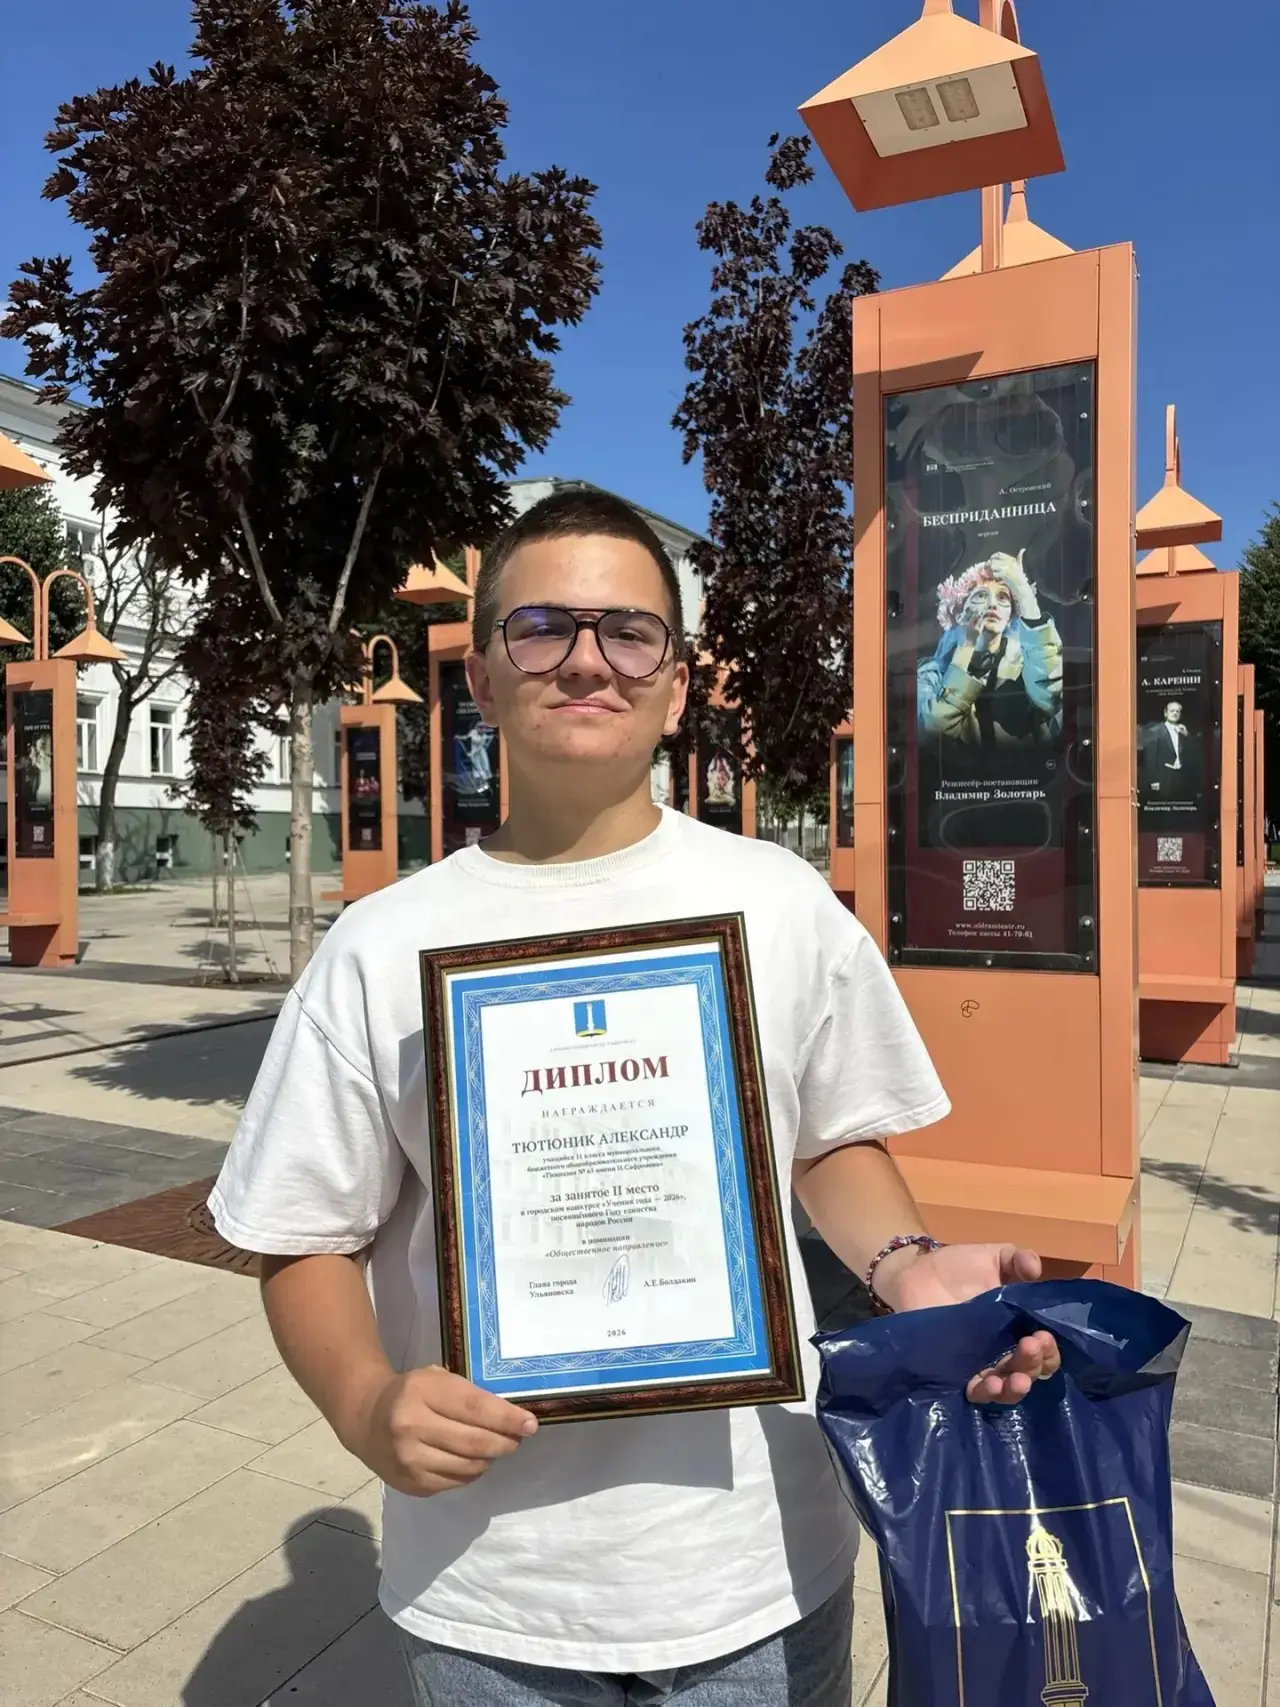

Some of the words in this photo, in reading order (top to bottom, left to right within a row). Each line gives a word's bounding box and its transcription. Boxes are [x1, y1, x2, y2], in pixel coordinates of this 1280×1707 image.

[1009, 482, 1051, 494] Островский
[923, 501, 1056, 528] БЕСПРИДАННИЦА
[1153, 676, 1201, 686] КАРЕНИН
[941, 778, 1038, 789] Режиссёр-постановщик
[935, 790, 990, 801] Владимир
[993, 788, 1046, 800] Золотарь
[948, 929, 977, 938] Телефон
[521, 1055, 670, 1098] ДИПЛОМ
[541, 1099, 656, 1119] НАГРАЖДАЕТСЯ
[512, 1134, 596, 1154] ТЮТЮНИК
[599, 1124, 689, 1146] АЛЕКСАНДР
[550, 1194, 562, 1203] за
[564, 1188, 610, 1201] занятое
[613, 1185, 622, 1196] II
[626, 1184, 660, 1195] место
[526, 1206, 565, 1216] городском
[566, 1203, 600, 1212] конкурсе
[605, 1209, 621, 1218] Году
[624, 1206, 657, 1215] единства
[576, 1219, 606, 1229] народов
[607, 1217, 633, 1226] России
[588, 1235, 630, 1245] номинации
[545, 1246, 611, 1259] «Общественное
[529, 1281, 551, 1289] Глава
[552, 1278, 577, 1288] города
[530, 1289, 574, 1299] Ульяновска
[607, 1329, 627, 1338] 2026
